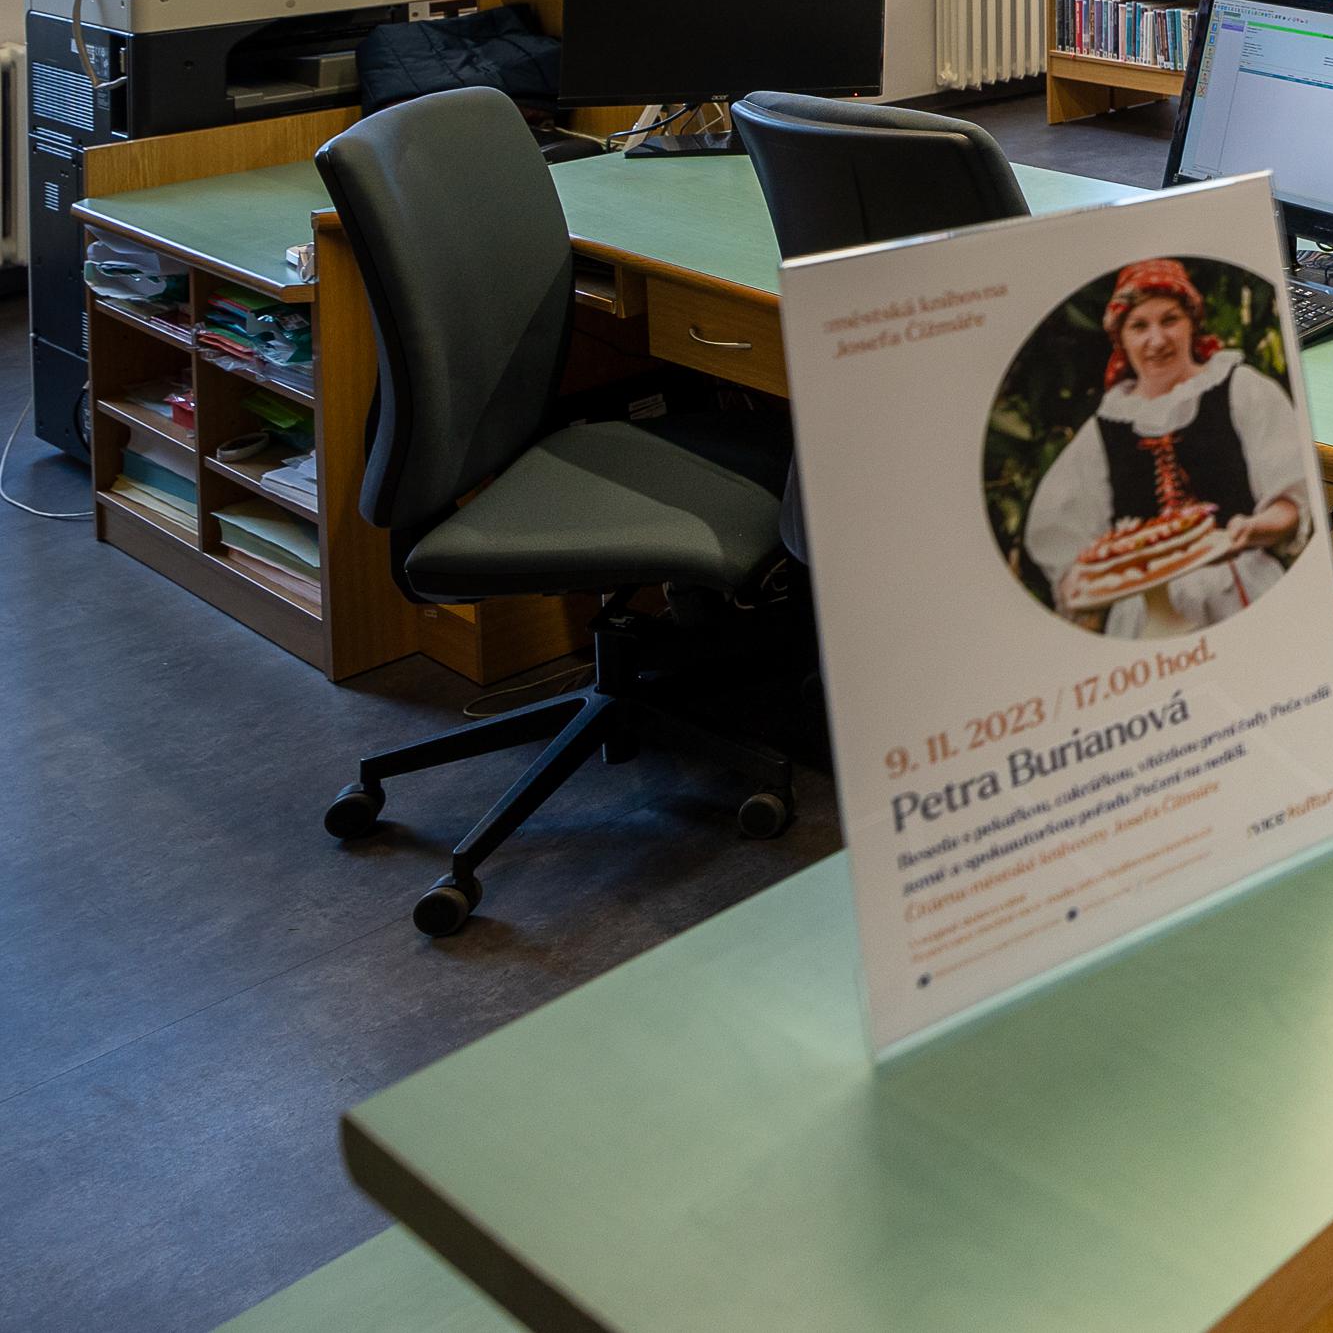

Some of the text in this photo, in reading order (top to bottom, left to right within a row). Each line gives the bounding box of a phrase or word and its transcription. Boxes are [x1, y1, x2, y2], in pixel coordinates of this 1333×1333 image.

[917, 277, 1009, 313] knihovna
[832, 322, 900, 360] Josefa
[884, 745, 917, 779] 9.
[966, 697, 1046, 749] 2023
[1073, 656, 1151, 710] 17.00
[1155, 637, 1217, 680] hod.
[891, 688, 1190, 833] Petra Burianová
